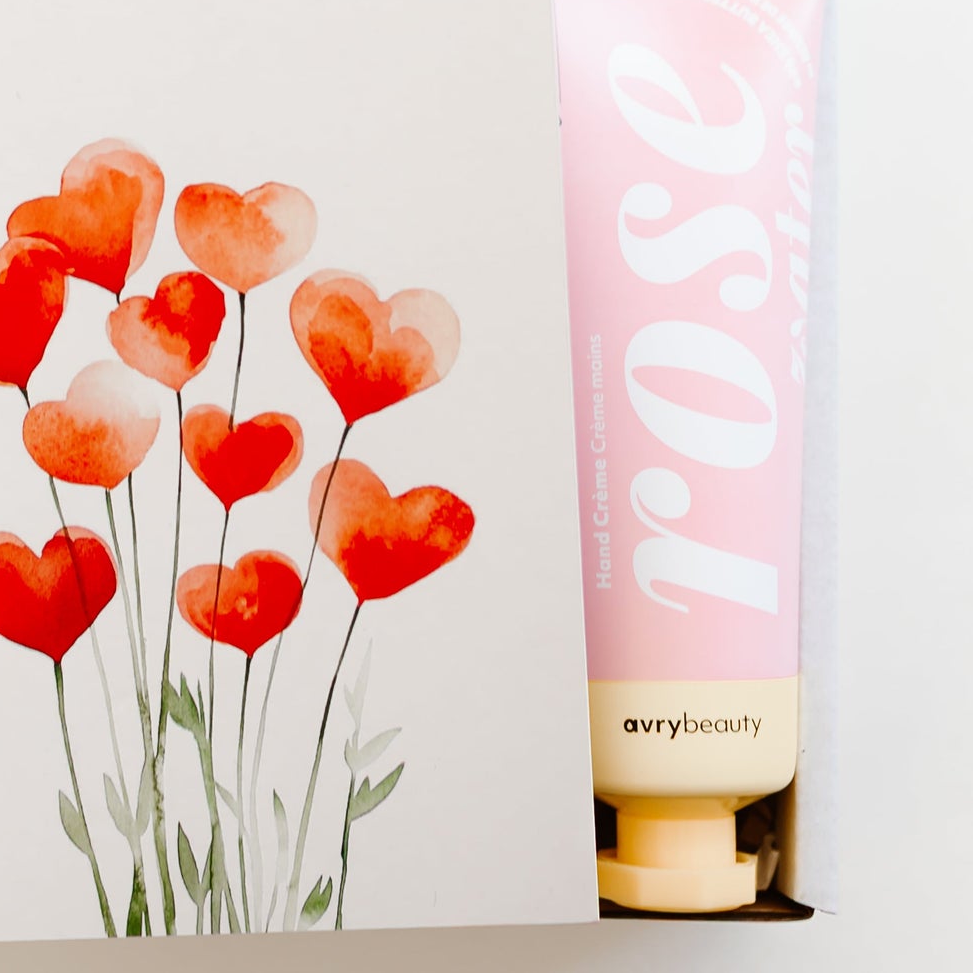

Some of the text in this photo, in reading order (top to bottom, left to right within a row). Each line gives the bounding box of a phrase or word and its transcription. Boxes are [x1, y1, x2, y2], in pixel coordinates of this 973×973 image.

[608, 42, 778, 615] rose
[587, 333, 611, 589] Hand Crème Crème mains
[623, 712, 762, 740] avrybeauty
